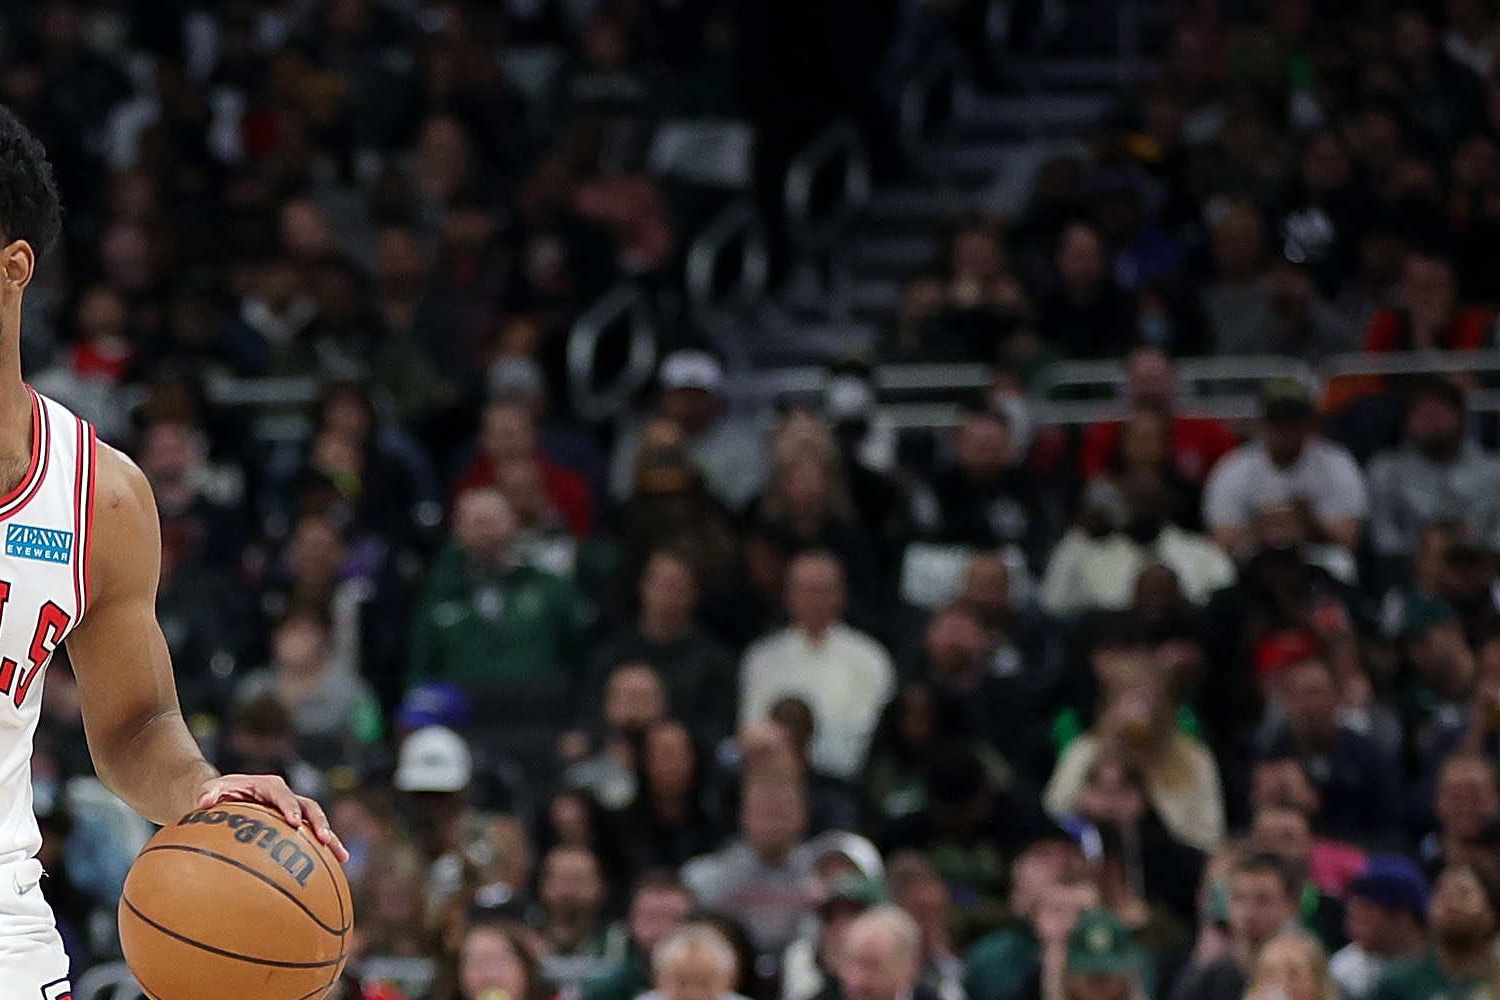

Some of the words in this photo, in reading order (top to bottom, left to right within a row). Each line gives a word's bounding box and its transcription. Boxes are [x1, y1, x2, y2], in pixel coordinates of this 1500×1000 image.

[8, 526, 71, 549] ZENNI
[7, 544, 68, 562] EYEWEAR
[177, 810, 315, 889] Wilson
